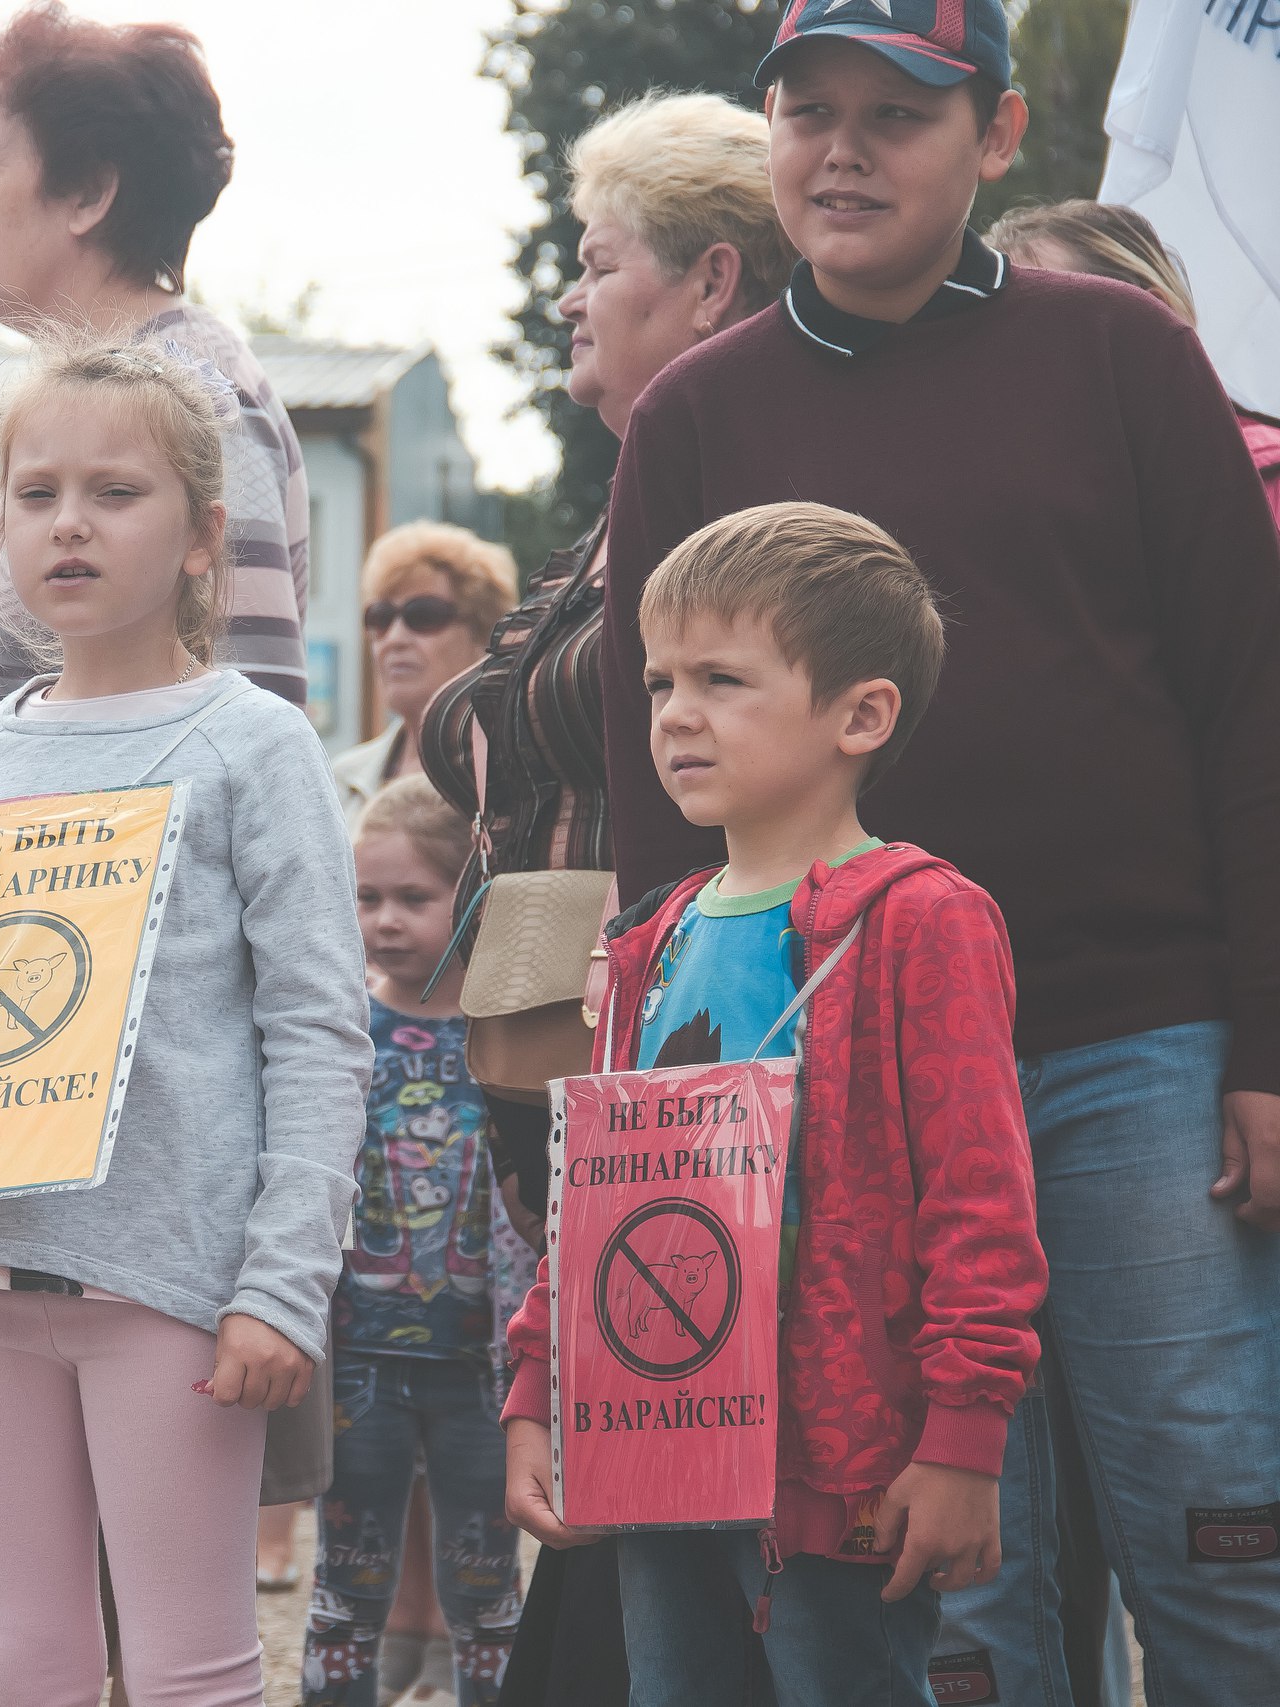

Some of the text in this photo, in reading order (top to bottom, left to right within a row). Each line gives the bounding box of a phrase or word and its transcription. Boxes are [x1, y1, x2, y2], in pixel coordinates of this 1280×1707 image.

[13, 817, 116, 853] БЫТЬ
[608, 1094, 748, 1133] НЕ БЫТЬ
[568, 1145, 781, 1188] СВИНАРНИКУ
[574, 1389, 766, 1433] В ЗАРАЙСКЕ!
[1218, 1533, 1261, 1547] STS
[932, 1679, 972, 1694] STS
